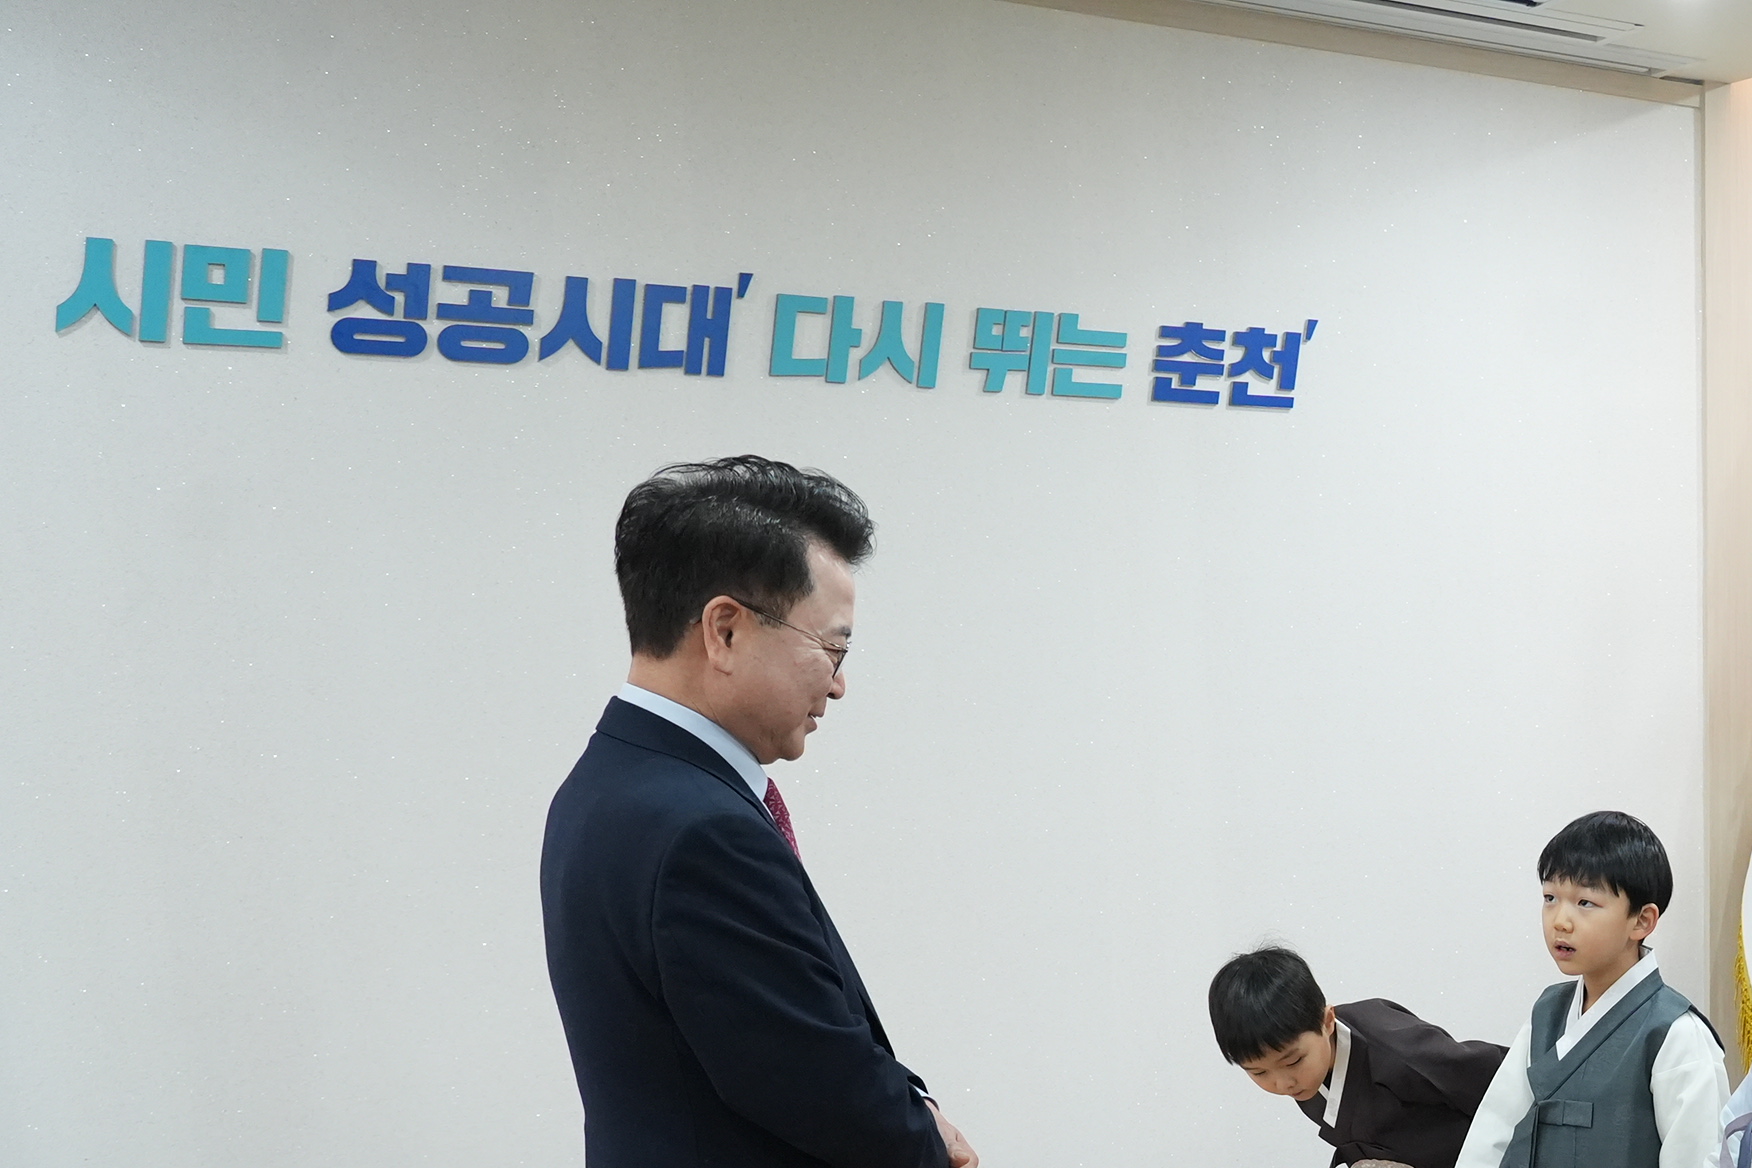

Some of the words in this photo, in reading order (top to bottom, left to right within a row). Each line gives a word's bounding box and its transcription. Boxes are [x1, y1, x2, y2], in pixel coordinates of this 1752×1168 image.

[55, 237, 291, 348] 시민
[769, 293, 945, 389] 다시
[970, 308, 1127, 399] 뛰는
